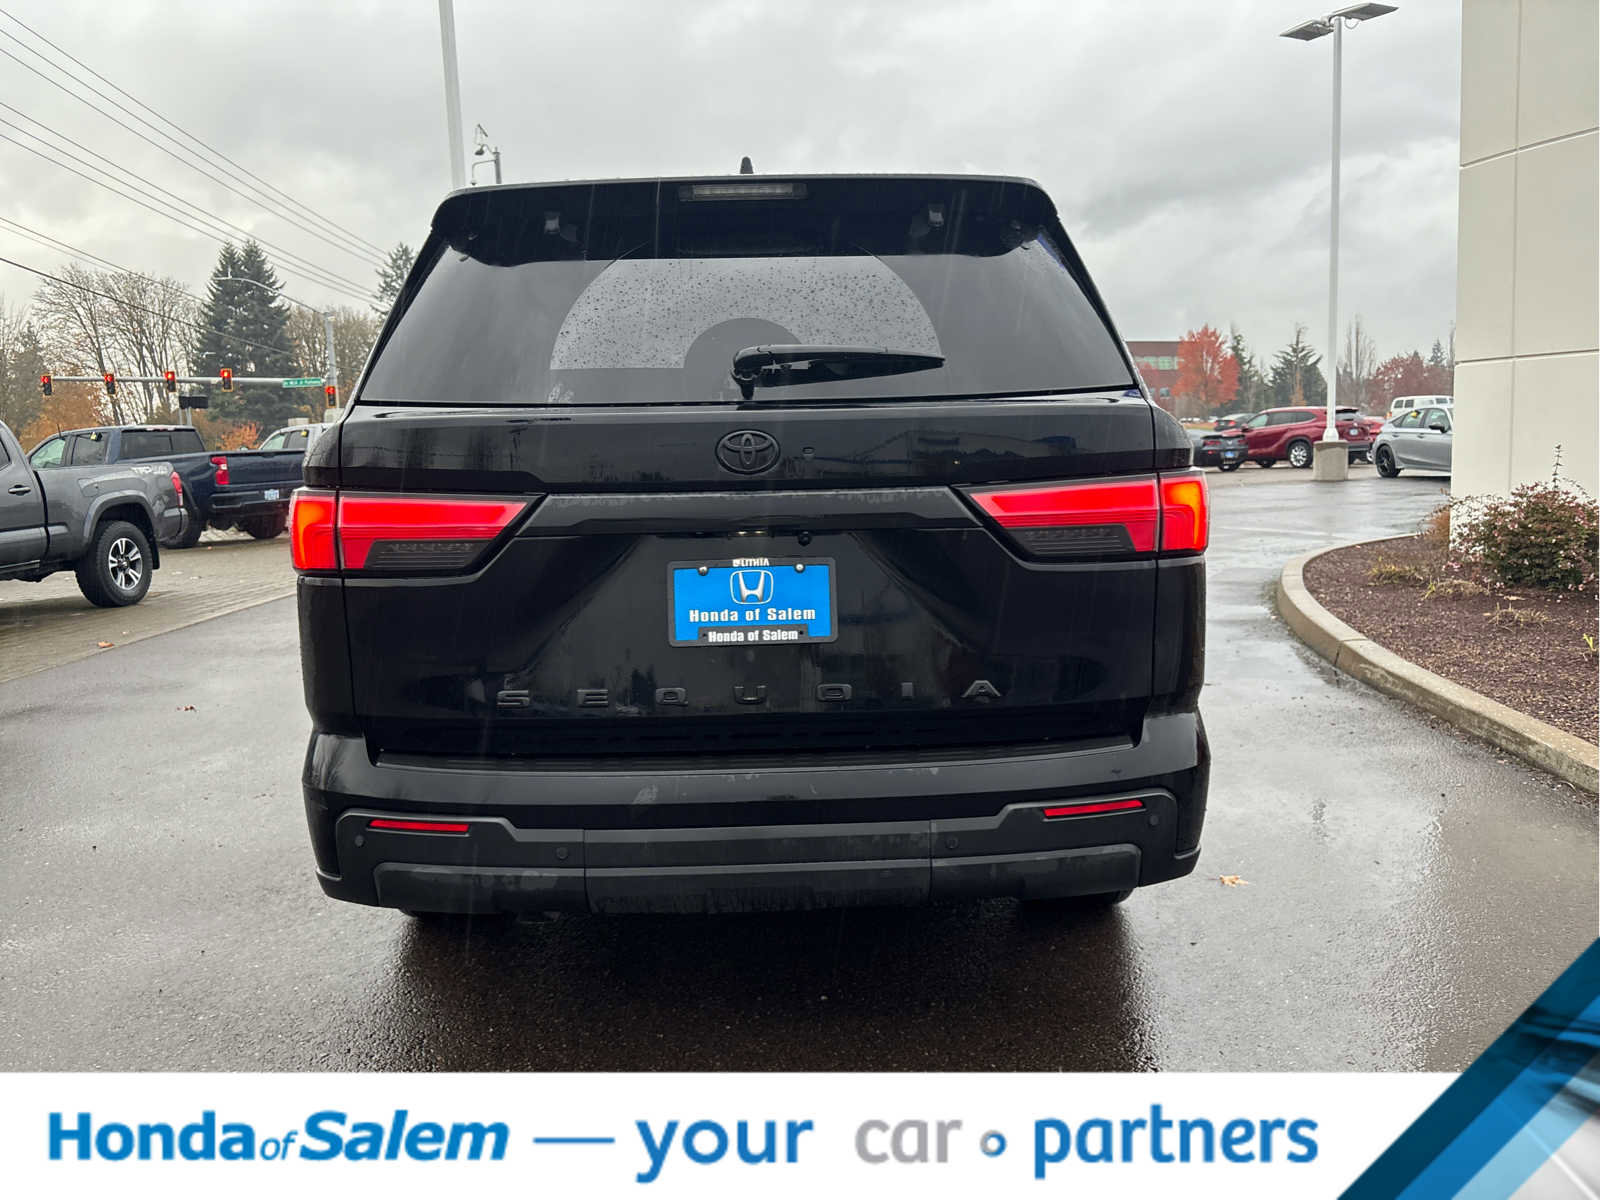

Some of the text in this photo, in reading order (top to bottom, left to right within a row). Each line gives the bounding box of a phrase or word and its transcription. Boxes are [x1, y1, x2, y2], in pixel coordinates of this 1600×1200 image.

[739, 557, 770, 566] LITHIA
[689, 608, 816, 622] Honda of Salem
[708, 630, 799, 643] Honda of Salem
[496, 679, 1002, 708] SEQUOIA
